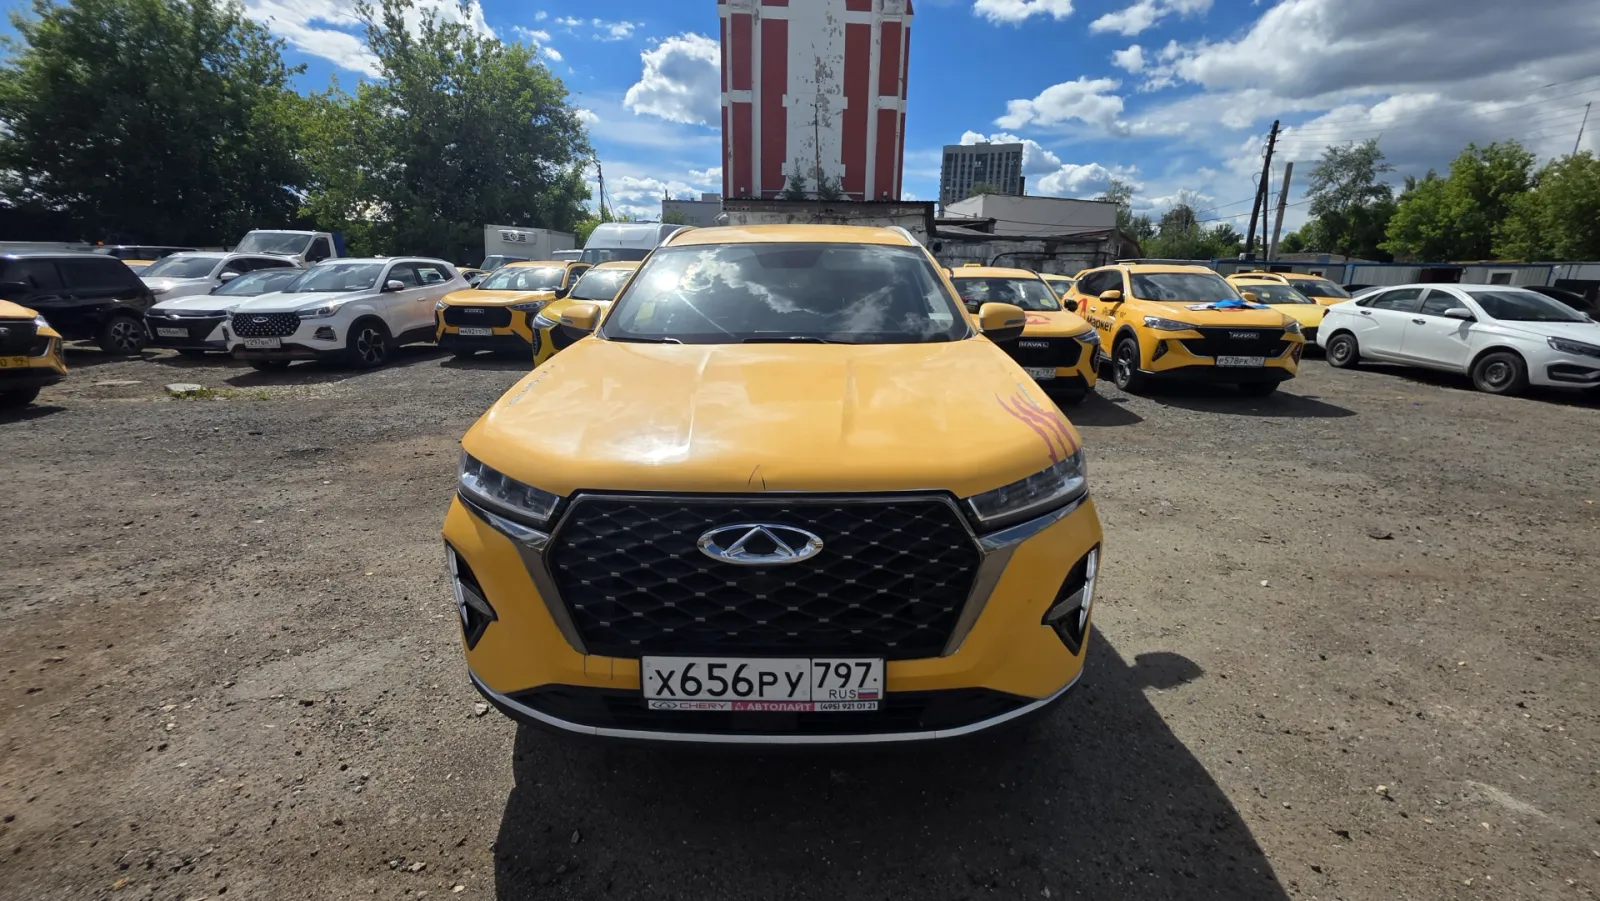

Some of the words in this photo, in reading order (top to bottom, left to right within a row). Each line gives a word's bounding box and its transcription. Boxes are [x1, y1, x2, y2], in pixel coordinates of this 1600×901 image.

[655, 662, 804, 698] Х656РУ
[813, 662, 873, 689] 797
[828, 689, 857, 699] RUS
[679, 702, 728, 710] CHERY
[747, 701, 814, 712] АВТОЛАЙТ
[820, 702, 841, 711] (495)
[841, 702, 856, 710] 921
[856, 702, 866, 710] 01
[866, 702, 877, 710] 21
